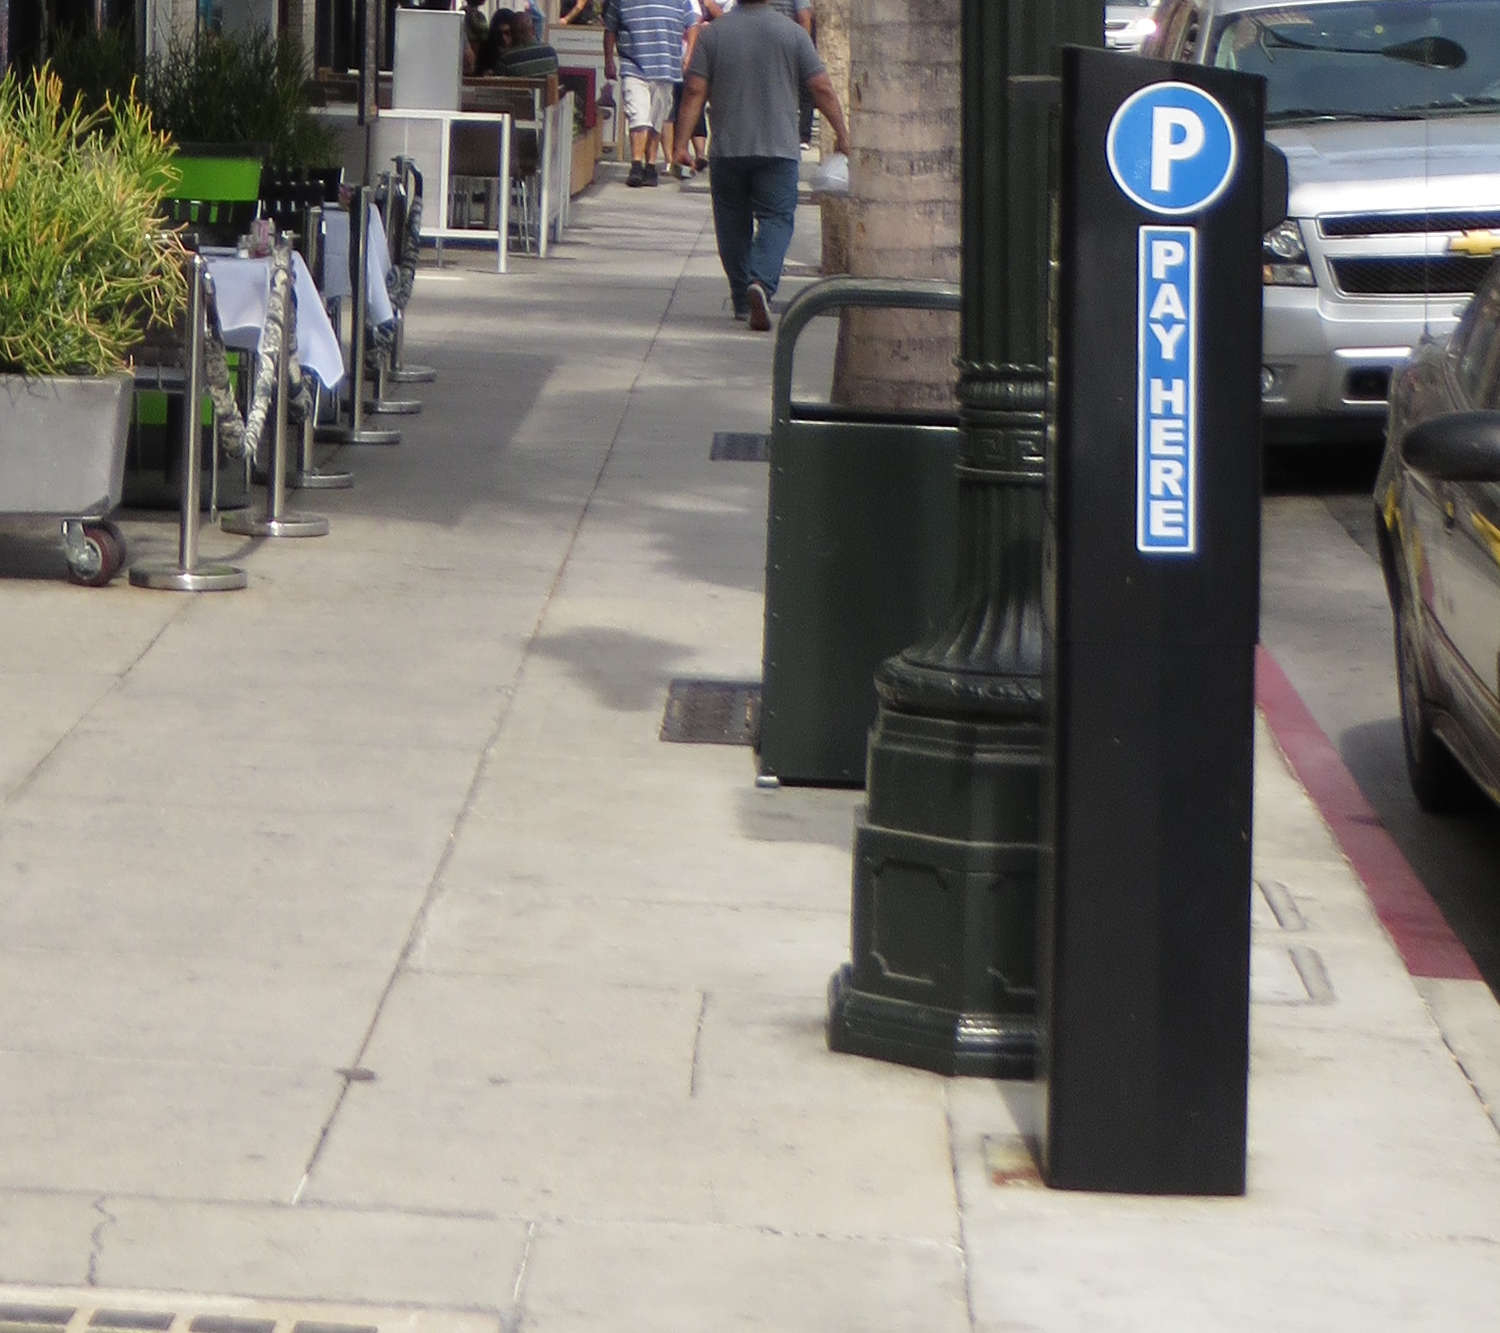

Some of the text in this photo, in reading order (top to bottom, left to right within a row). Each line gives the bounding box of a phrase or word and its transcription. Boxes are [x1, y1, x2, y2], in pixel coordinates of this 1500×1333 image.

[1150, 106, 1206, 192] P
[1148, 240, 1186, 538] PAY HERE
